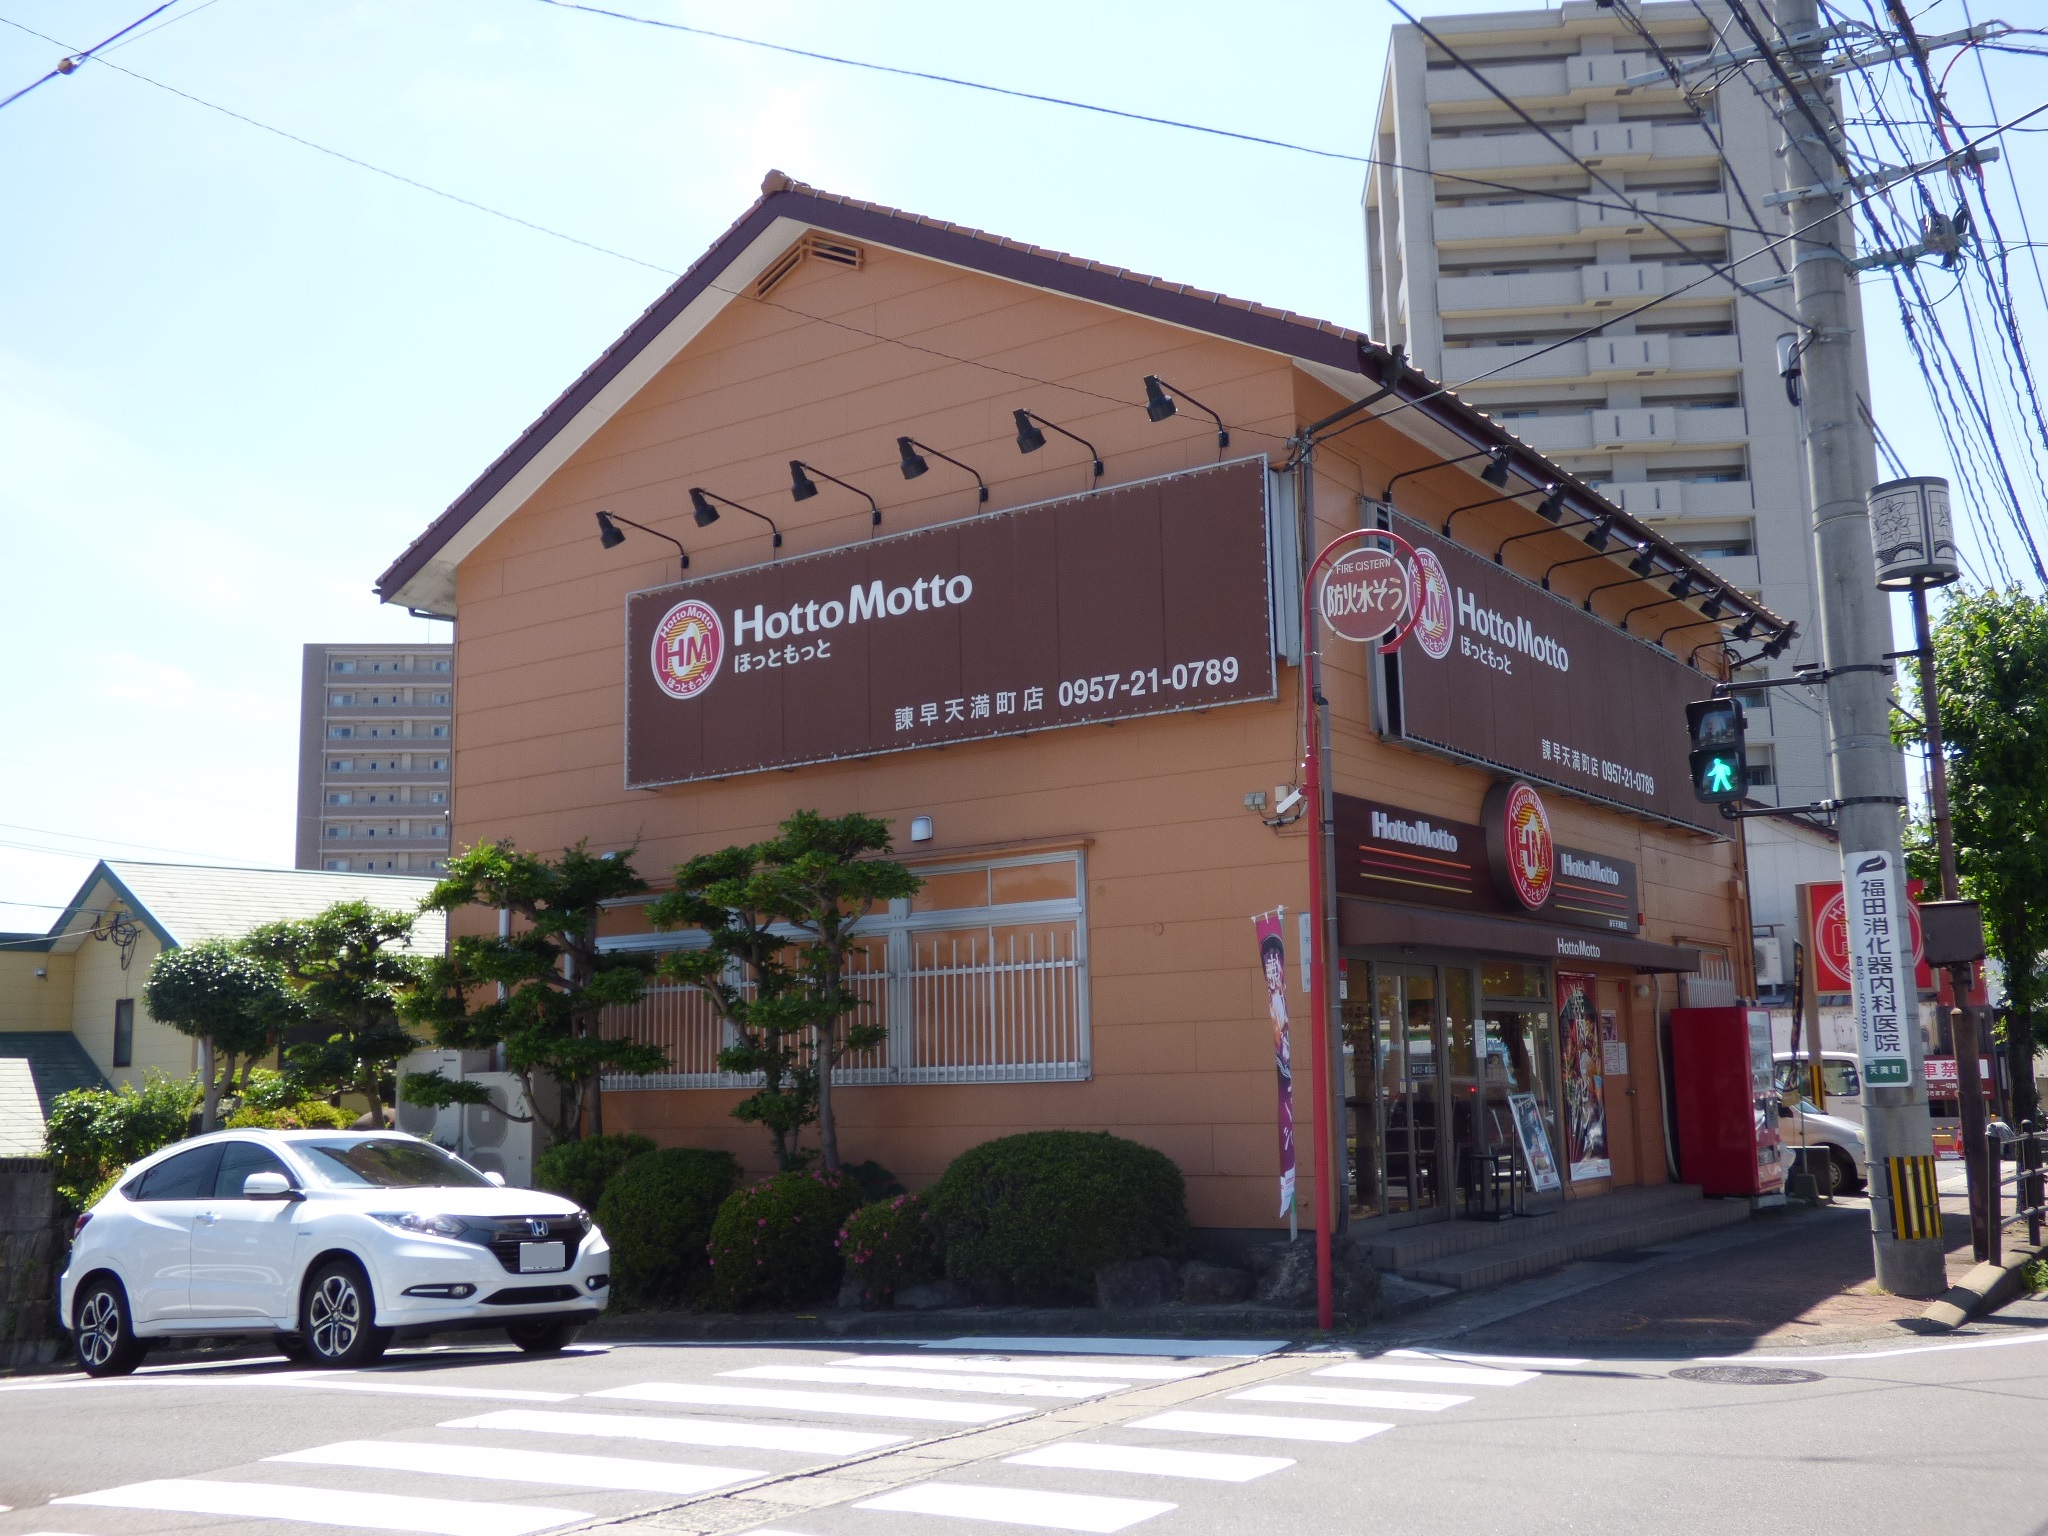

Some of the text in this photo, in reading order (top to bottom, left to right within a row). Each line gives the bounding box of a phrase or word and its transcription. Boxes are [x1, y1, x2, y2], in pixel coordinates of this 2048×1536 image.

[1336, 558, 1391, 574] FIRE CISTERN
[1327, 577, 1403, 617] 防火水そう
[661, 631, 713, 672] HM
[734, 639, 831, 674] ほっともっと
[1460, 634, 1512, 675] ほっともっと
[666, 671, 709, 692] ほっともっと
[894, 656, 1240, 731] 諫早天満町店 0957-21-0789
[1541, 738, 1655, 796] 諫早天満町店 0957-21-0789
[1520, 876, 1549, 901] ほっともっと
[1861, 878, 1901, 1053] 福田消化器内科医院
[1869, 1065, 1901, 1075] 天満町
